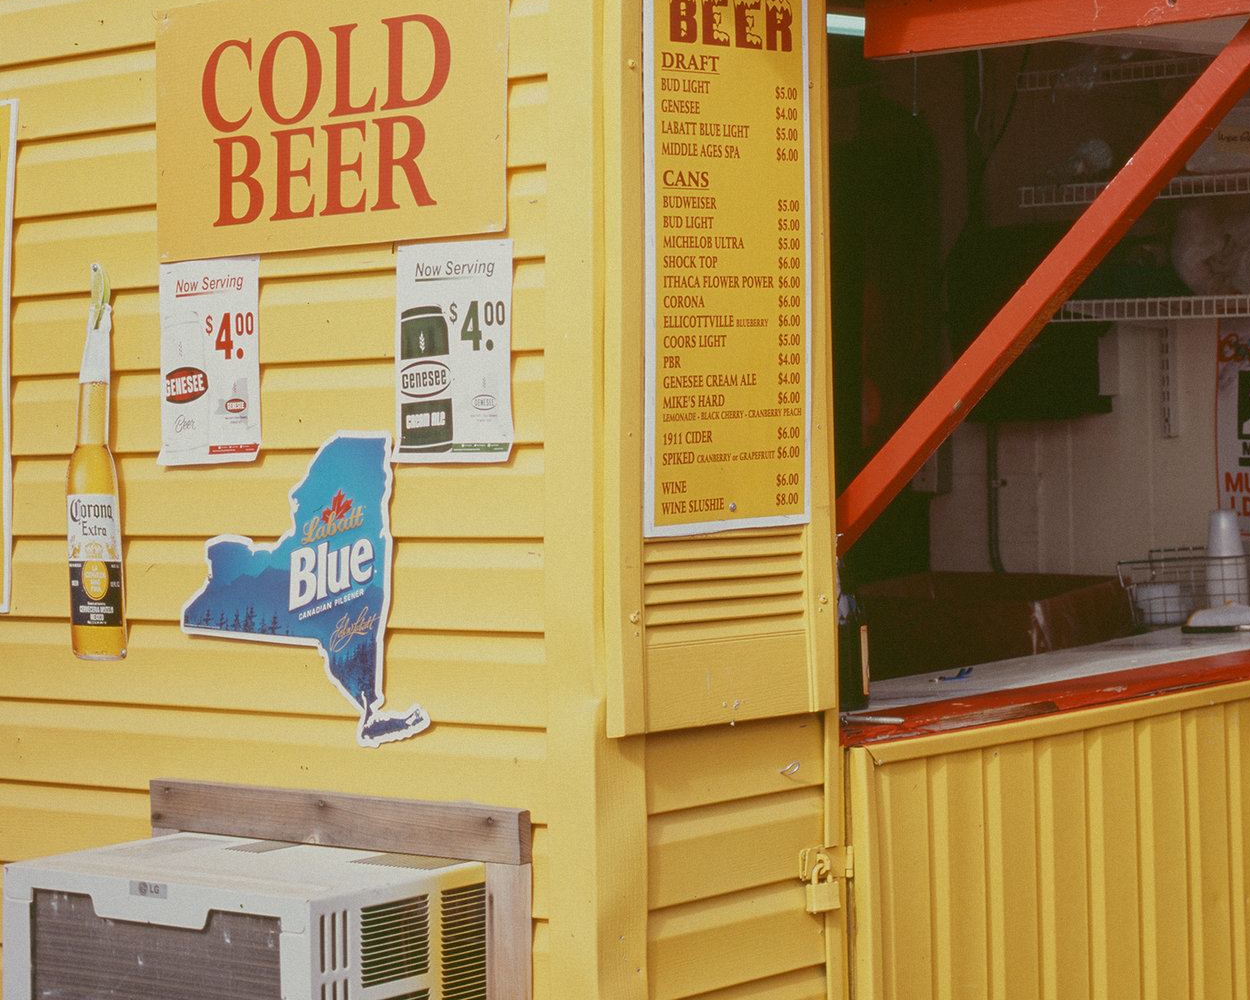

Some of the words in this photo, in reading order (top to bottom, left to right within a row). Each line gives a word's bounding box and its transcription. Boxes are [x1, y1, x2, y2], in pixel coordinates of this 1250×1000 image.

[661, 52, 720, 72] DRAFT
[201, 13, 452, 133] COLD
[661, 77, 680, 92] BUD
[682, 79, 710, 94] LIGHT
[775, 86, 797, 101] $5.00
[661, 99, 700, 115] GENESEE
[775, 107, 798, 121] $4.00
[661, 121, 697, 136] LABATT
[700, 123, 721, 137] BLUE
[723, 124, 749, 139] LIGHT
[776, 127, 798, 141] $5.00
[662, 142, 698, 157] MIDDLE
[700, 143, 722, 158] AGES
[724, 145, 740, 159] SPA
[776, 148, 798, 162] $6.00
[213, 114, 437, 228] BEER
[663, 170, 709, 187] CANS
[663, 196, 717, 210] BUDWEISER
[777, 199, 800, 213] $5.00
[663, 216, 682, 229] BUD
[684, 216, 714, 229] LIGHT
[778, 218, 800, 232] $5.00
[663, 235, 712, 249] MICHELOB
[714, 236, 744, 249] ULTRA
[778, 237, 800, 251] $5.00
[415, 262, 441, 277] Now
[445, 260, 495, 277] Serving
[663, 255, 696, 269] SHOCK
[699, 255, 718, 268] TOP
[778, 257, 800, 270] $6.00
[176, 278, 199, 293] Now
[202, 275, 243, 291] Serving
[663, 276, 700, 288] ITHACA
[703, 275, 740, 288] FLOWER
[741, 275, 774, 288] POWER
[778, 276, 800, 289] $6.00
[663, 296, 705, 308] CORONA
[778, 295, 800, 308] $6.00
[663, 315, 734, 328] ELLICOTTVILLE
[736, 318, 768, 328] BLUEBERRY
[778, 314, 800, 328] $6.00
[663, 335, 697, 348] COORS
[698, 334, 727, 347] LIGHT
[778, 333, 800, 347] $5.00
[663, 355, 681, 369] PBR
[778, 352, 800, 366] $4.00
[166, 373, 205, 397] GENESEE
[663, 375, 703, 389] GENESEE
[706, 374, 738, 388] CREAM
[740, 373, 757, 386] ALE
[778, 372, 800, 385] $4.00
[663, 395, 696, 409] MIKE'S
[698, 394, 725, 408] HARD
[778, 391, 800, 405] $6.00
[175, 414, 197, 433] Beer
[663, 412, 696, 422] LEMONADE
[701, 411, 719, 421] BLACK
[720, 410, 743, 420] CHERRY
[748, 408, 782, 419] CRANBERRY
[783, 408, 802, 417] PEACH
[663, 432, 683, 446] 1911
[685, 431, 712, 444] CIDER
[777, 426, 800, 440] $6.00
[662, 451, 695, 466] SPIKED
[697, 453, 731, 464] CRANBERRY
[739, 450, 775, 461] GRAPEFRUIT
[777, 446, 800, 460] $6.00
[662, 481, 687, 495] WINE
[776, 473, 799, 487] $6.00
[70, 498, 114, 522] Corona
[662, 500, 687, 515] WINE
[688, 497, 725, 513] SLUSHIE
[775, 492, 798, 506] $8.00
[82, 521, 107, 536] Extra
[301, 506, 364, 545] Labatt
[288, 538, 374, 612] Blue
[298, 602, 332, 621] CANADIAN
[334, 589, 364, 606] PILSENER
[149, 884, 160, 895] LG
